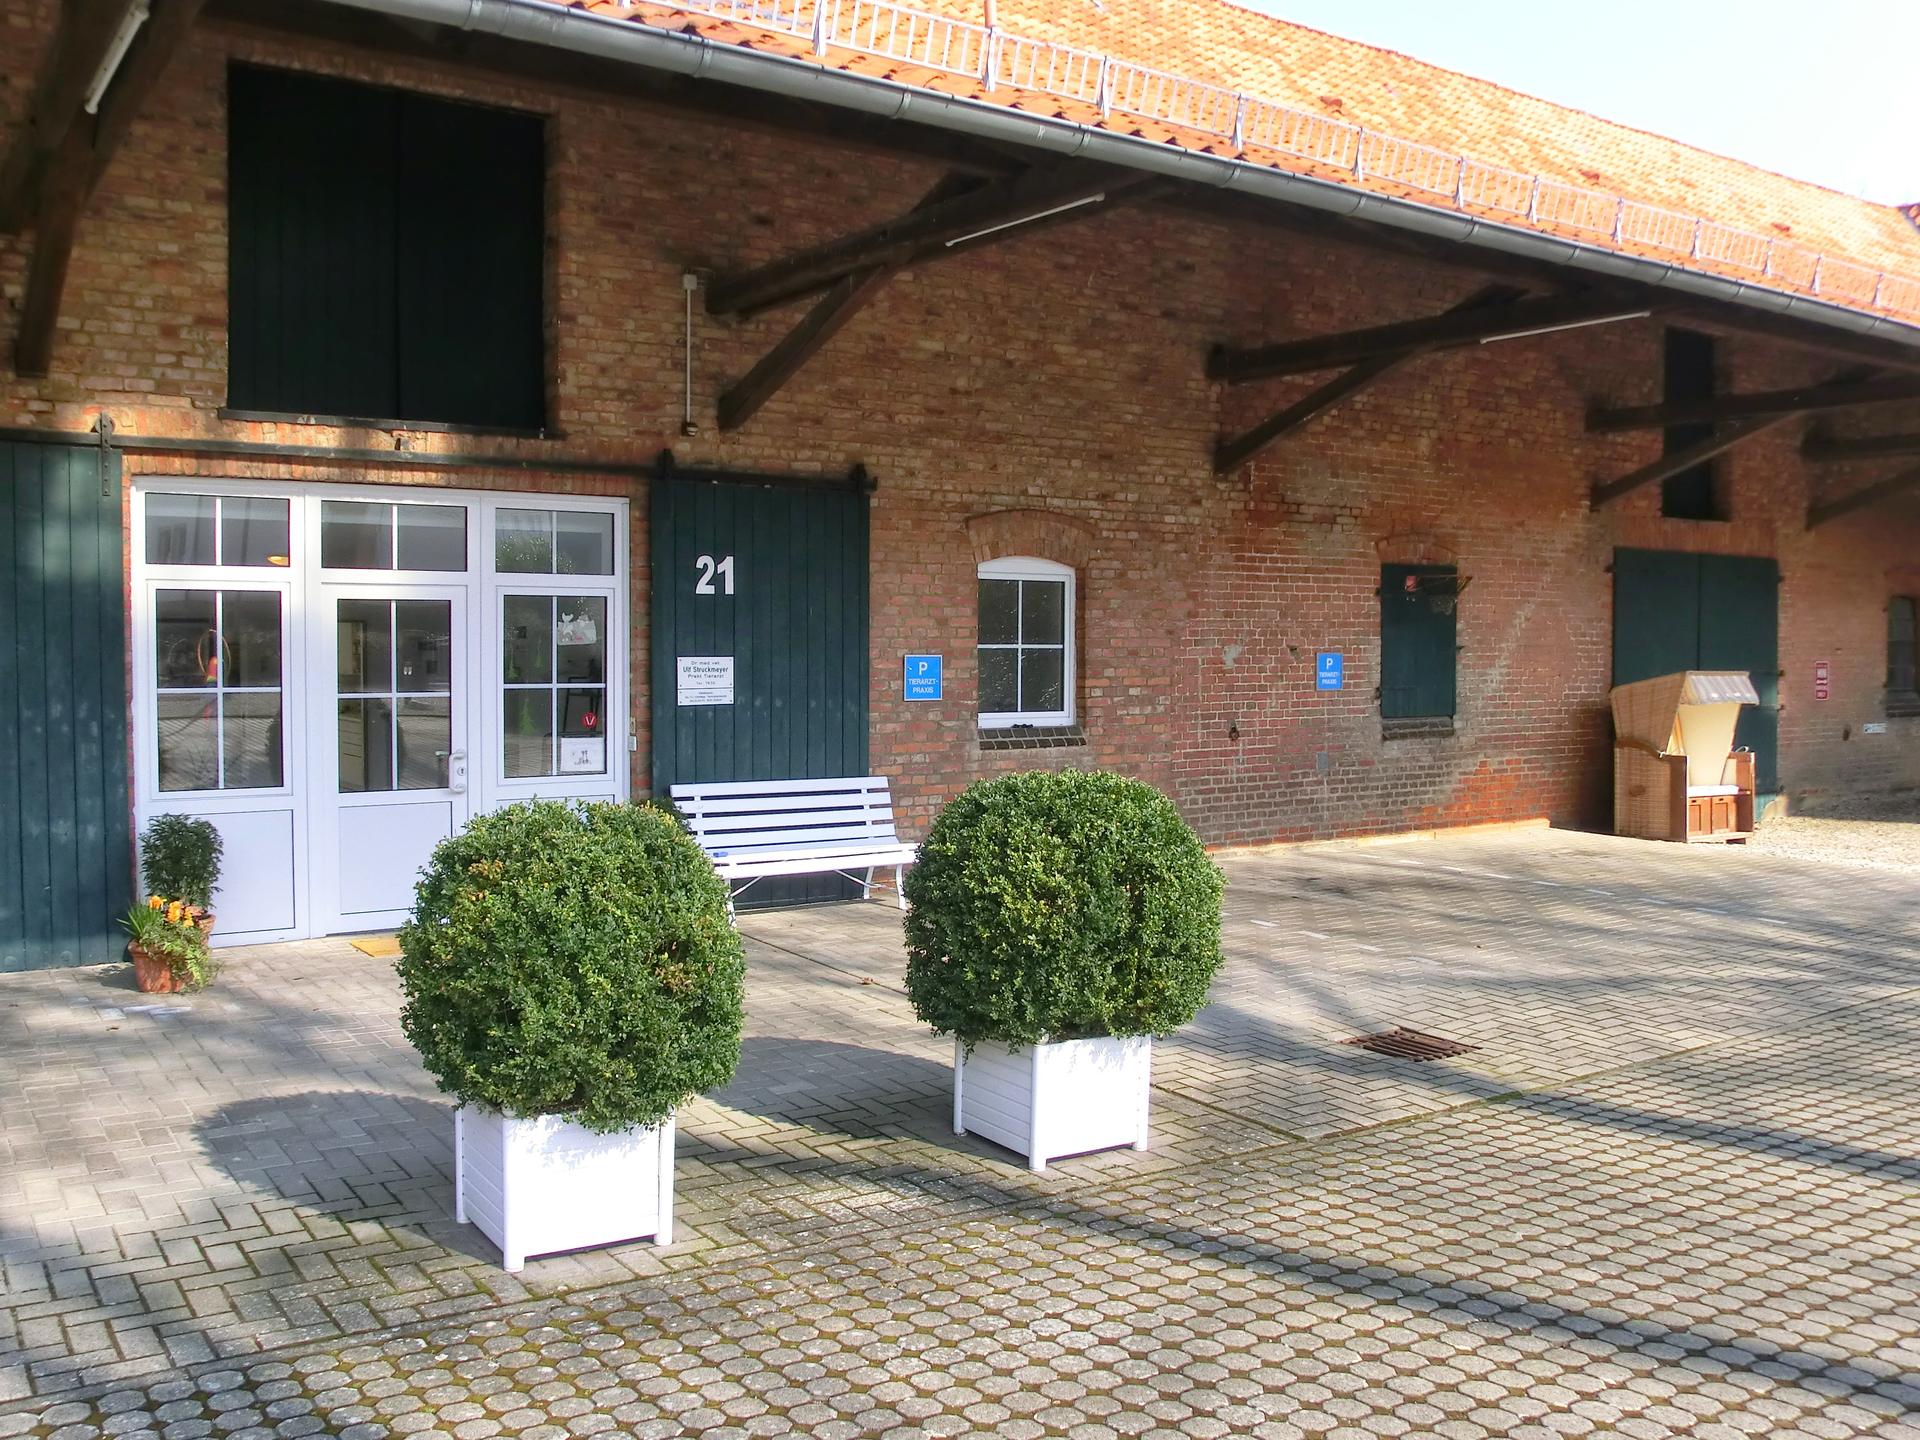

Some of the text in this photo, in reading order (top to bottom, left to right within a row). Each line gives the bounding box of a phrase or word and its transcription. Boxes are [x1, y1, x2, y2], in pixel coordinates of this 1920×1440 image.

[695, 555, 734, 595] 21
[693, 666, 728, 674] Struckmeyer
[919, 661, 928, 675] P
[1326, 657, 1333, 670] P
